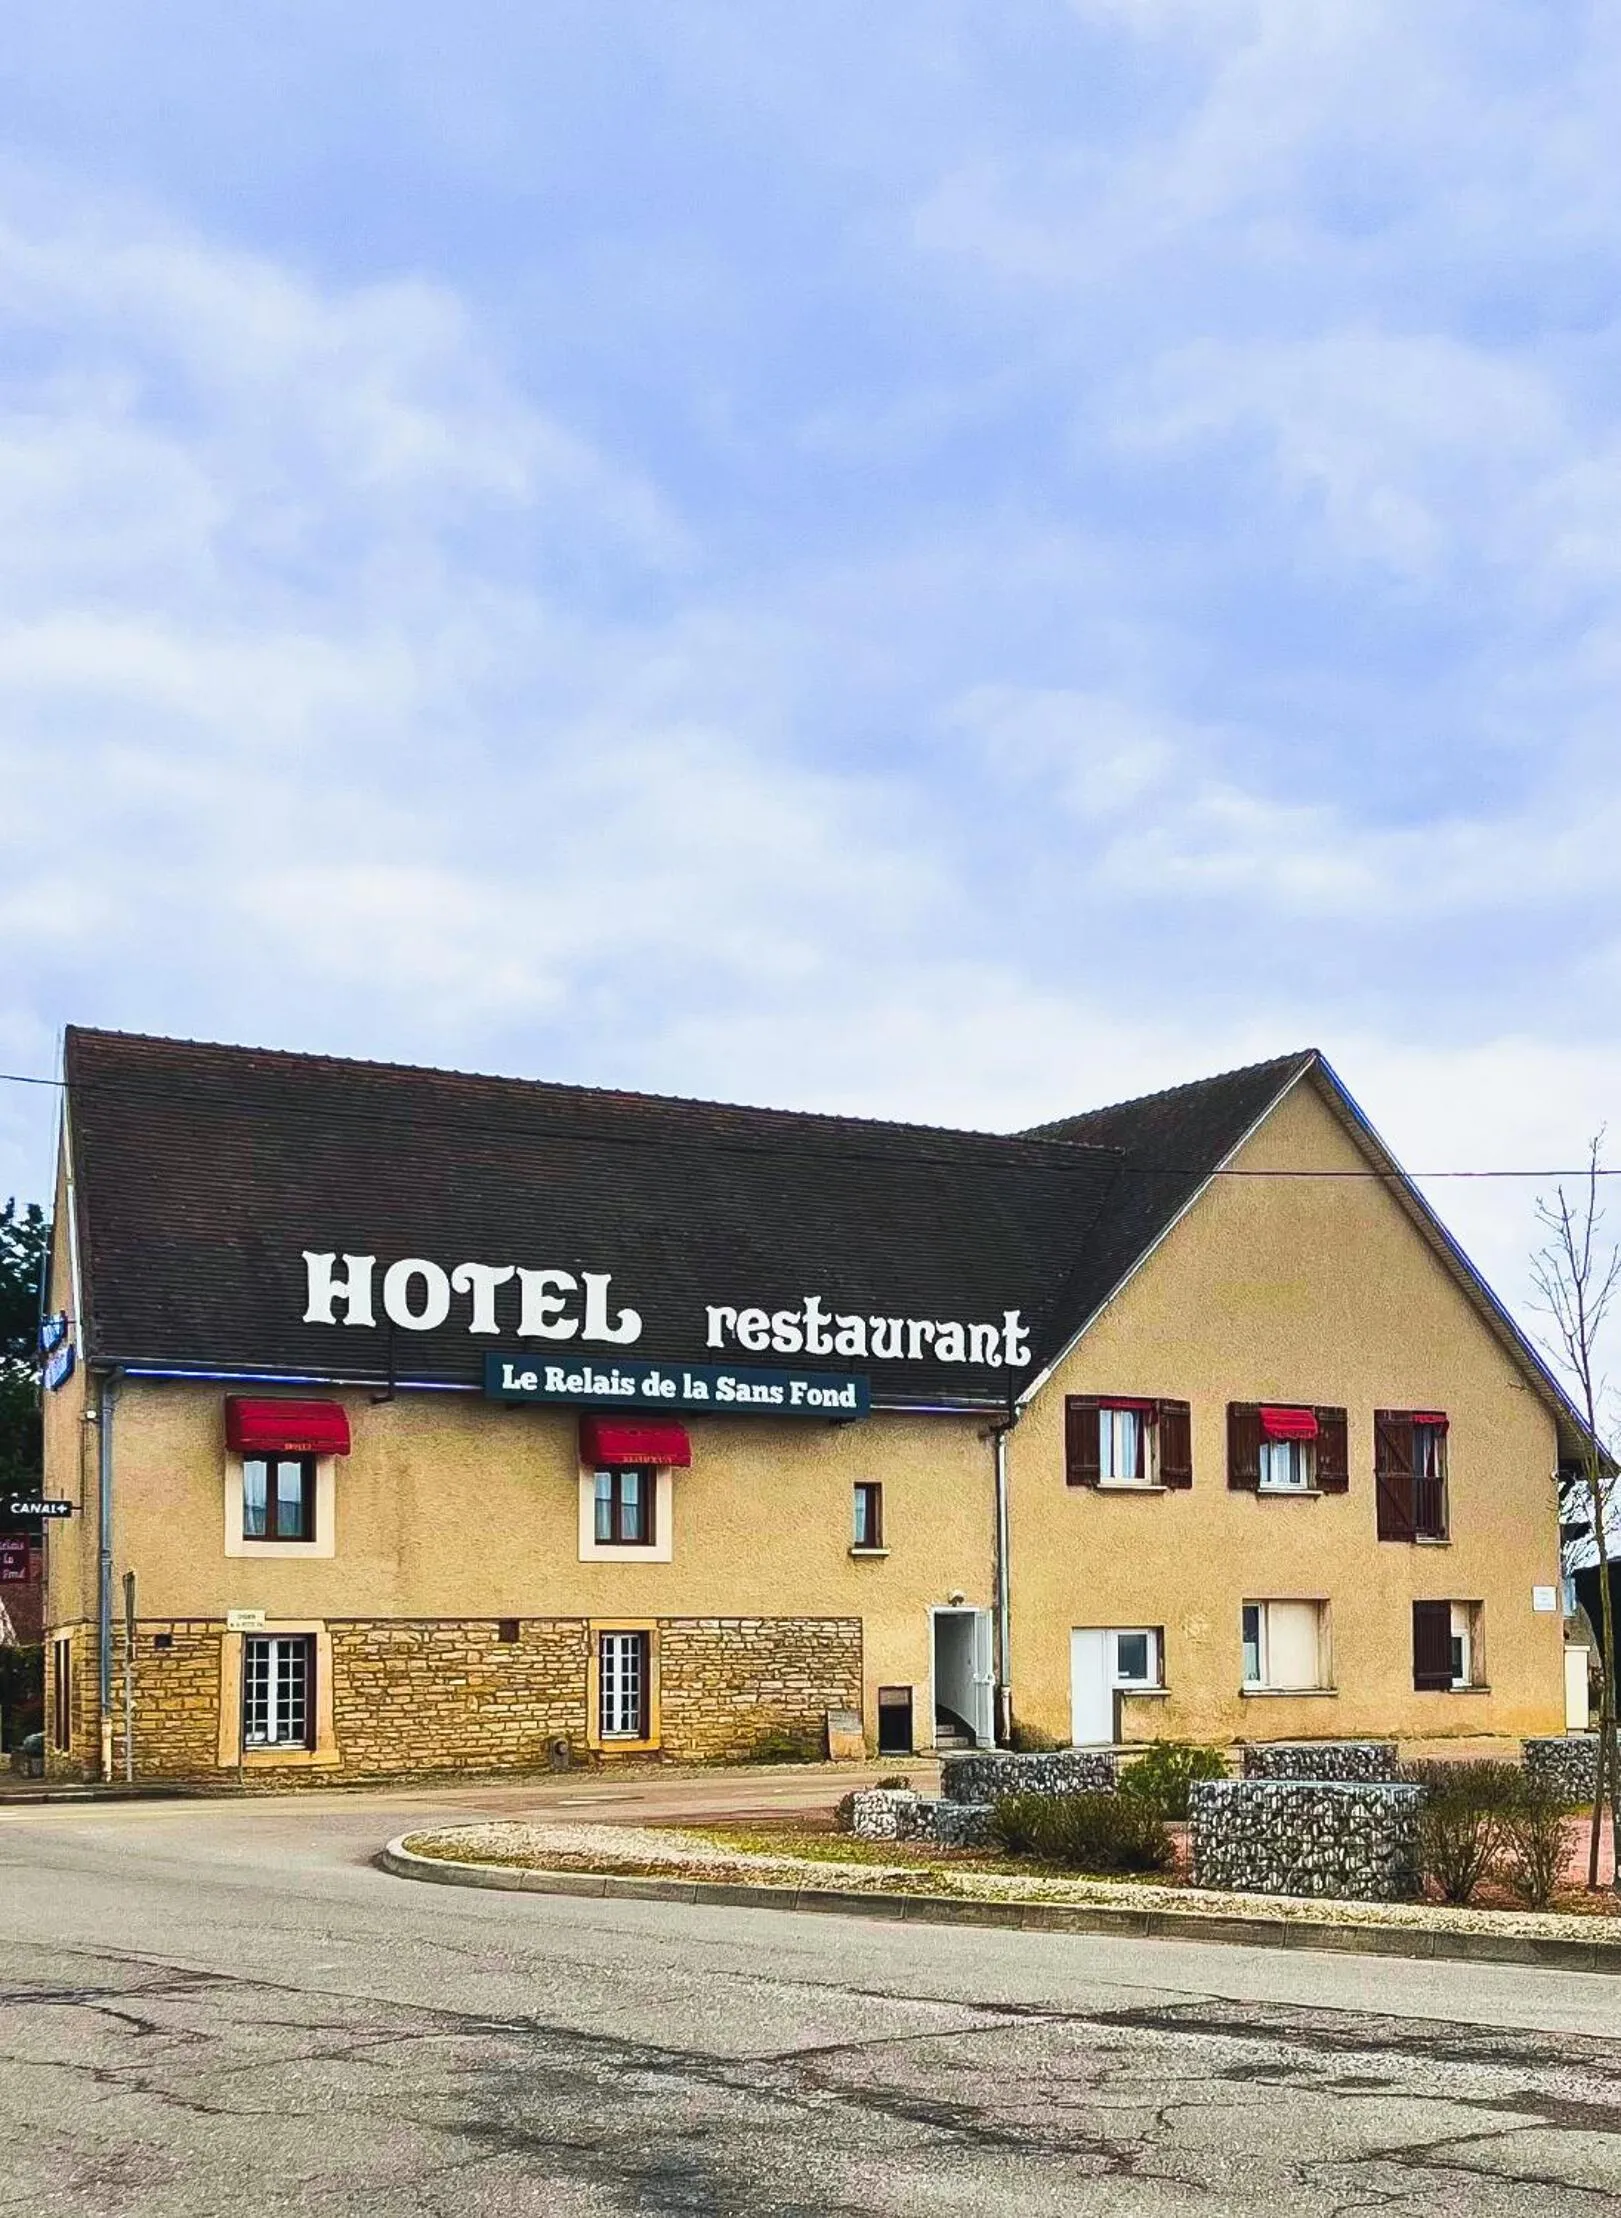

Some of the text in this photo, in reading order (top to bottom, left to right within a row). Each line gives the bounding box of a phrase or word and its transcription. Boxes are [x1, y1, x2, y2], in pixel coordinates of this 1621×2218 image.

[301, 1250, 1032, 1368] HOTEL restaurant
[502, 1364, 857, 1408] Le Relais de la Sans Fond
[10, 1503, 68, 1514] CANAL+
